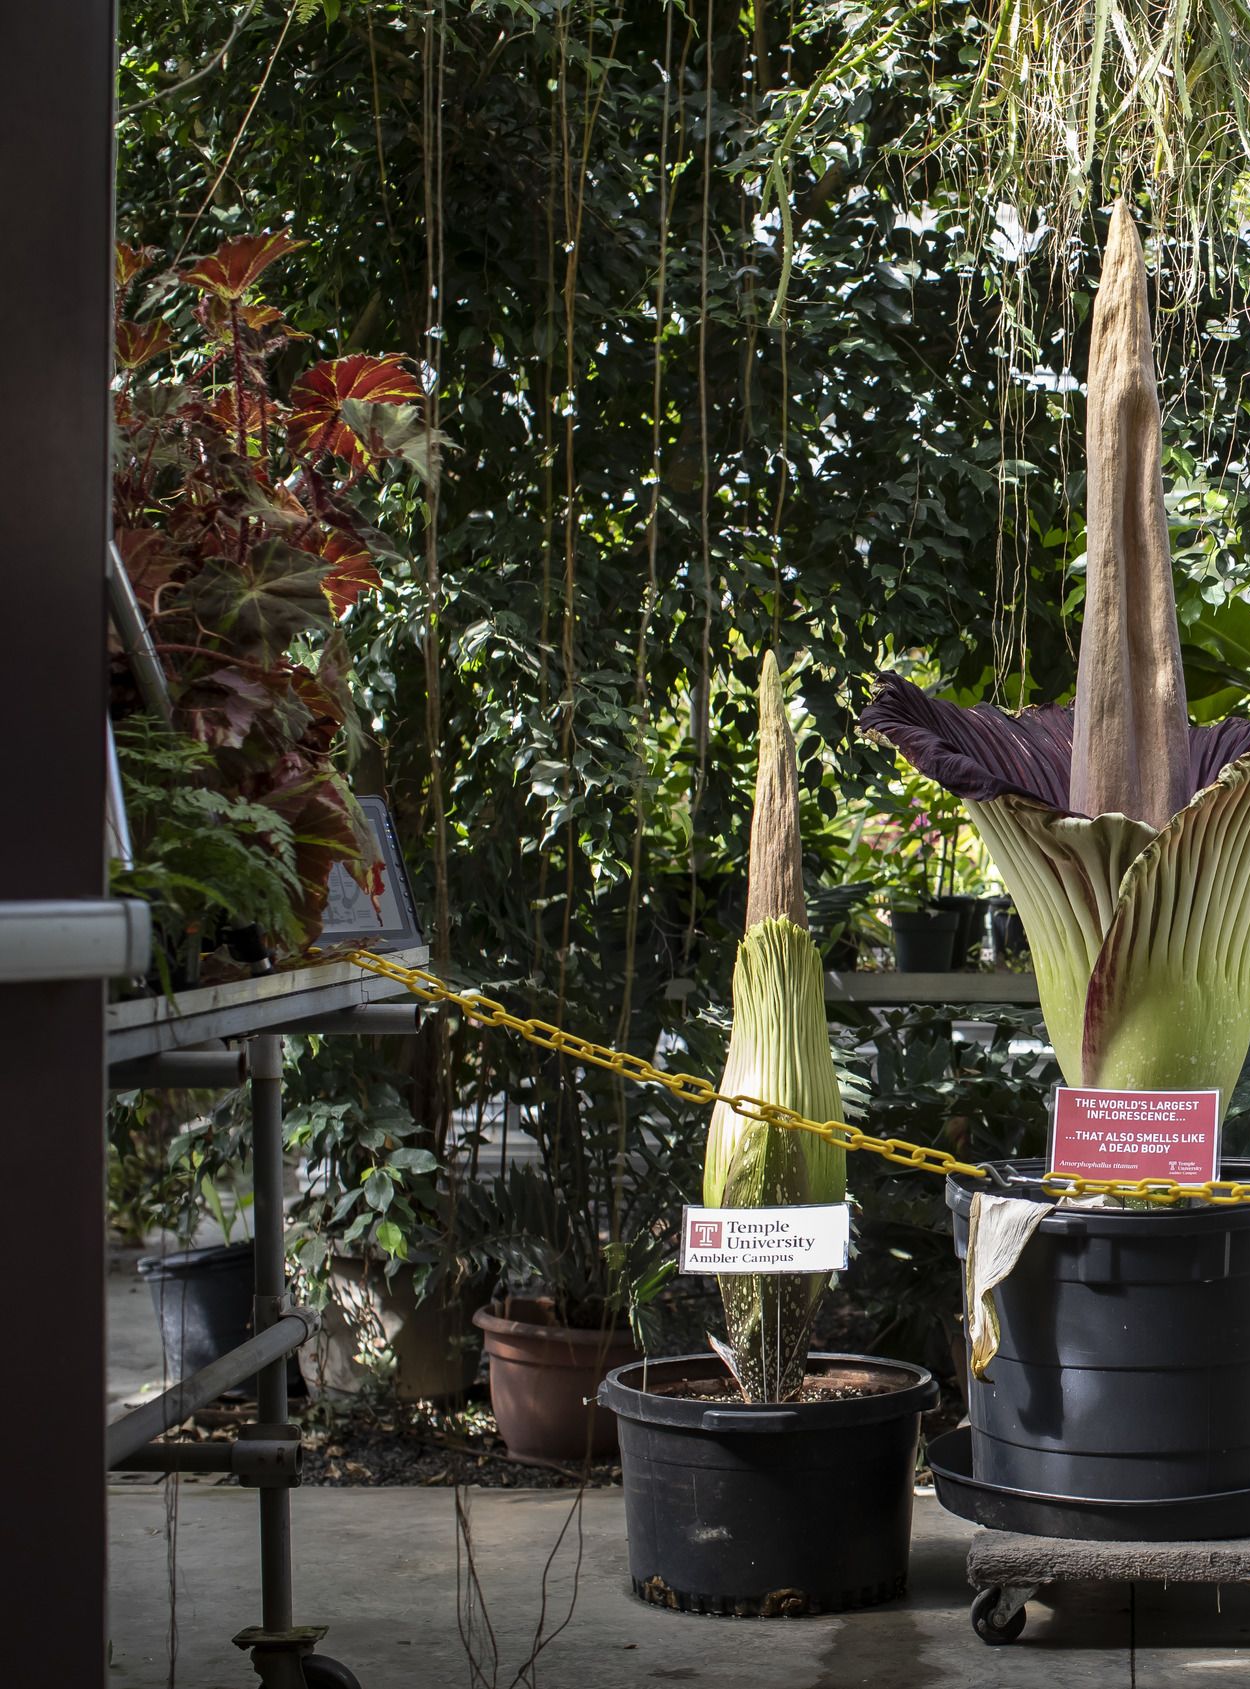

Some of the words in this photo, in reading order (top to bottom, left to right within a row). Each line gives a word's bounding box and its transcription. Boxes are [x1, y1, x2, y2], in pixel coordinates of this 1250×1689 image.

[1075, 1098, 1096, 1108] THE
[1099, 1099, 1148, 1110] WORLD'S
[1149, 1101, 1199, 1111] LARGEST
[1087, 1109, 1186, 1121] INFLORESCENCE...
[1065, 1130, 1104, 1141] ...THAT
[1105, 1132, 1135, 1142] ALSO
[1136, 1133, 1179, 1143] SMELLS
[1181, 1133, 1205, 1143] LIKE
[1099, 1142, 1107, 1152] A
[1109, 1143, 1139, 1153] DEAD
[1141, 1144, 1171, 1154] BODY
[1059, 1159, 1112, 1169] Amorphophallus
[1113, 1162, 1138, 1170] titanum
[727, 1220, 790, 1237] Temple
[727, 1235, 815, 1251] University
[689, 1253, 739, 1264] Ambler
[742, 1253, 794, 1265] Campus
